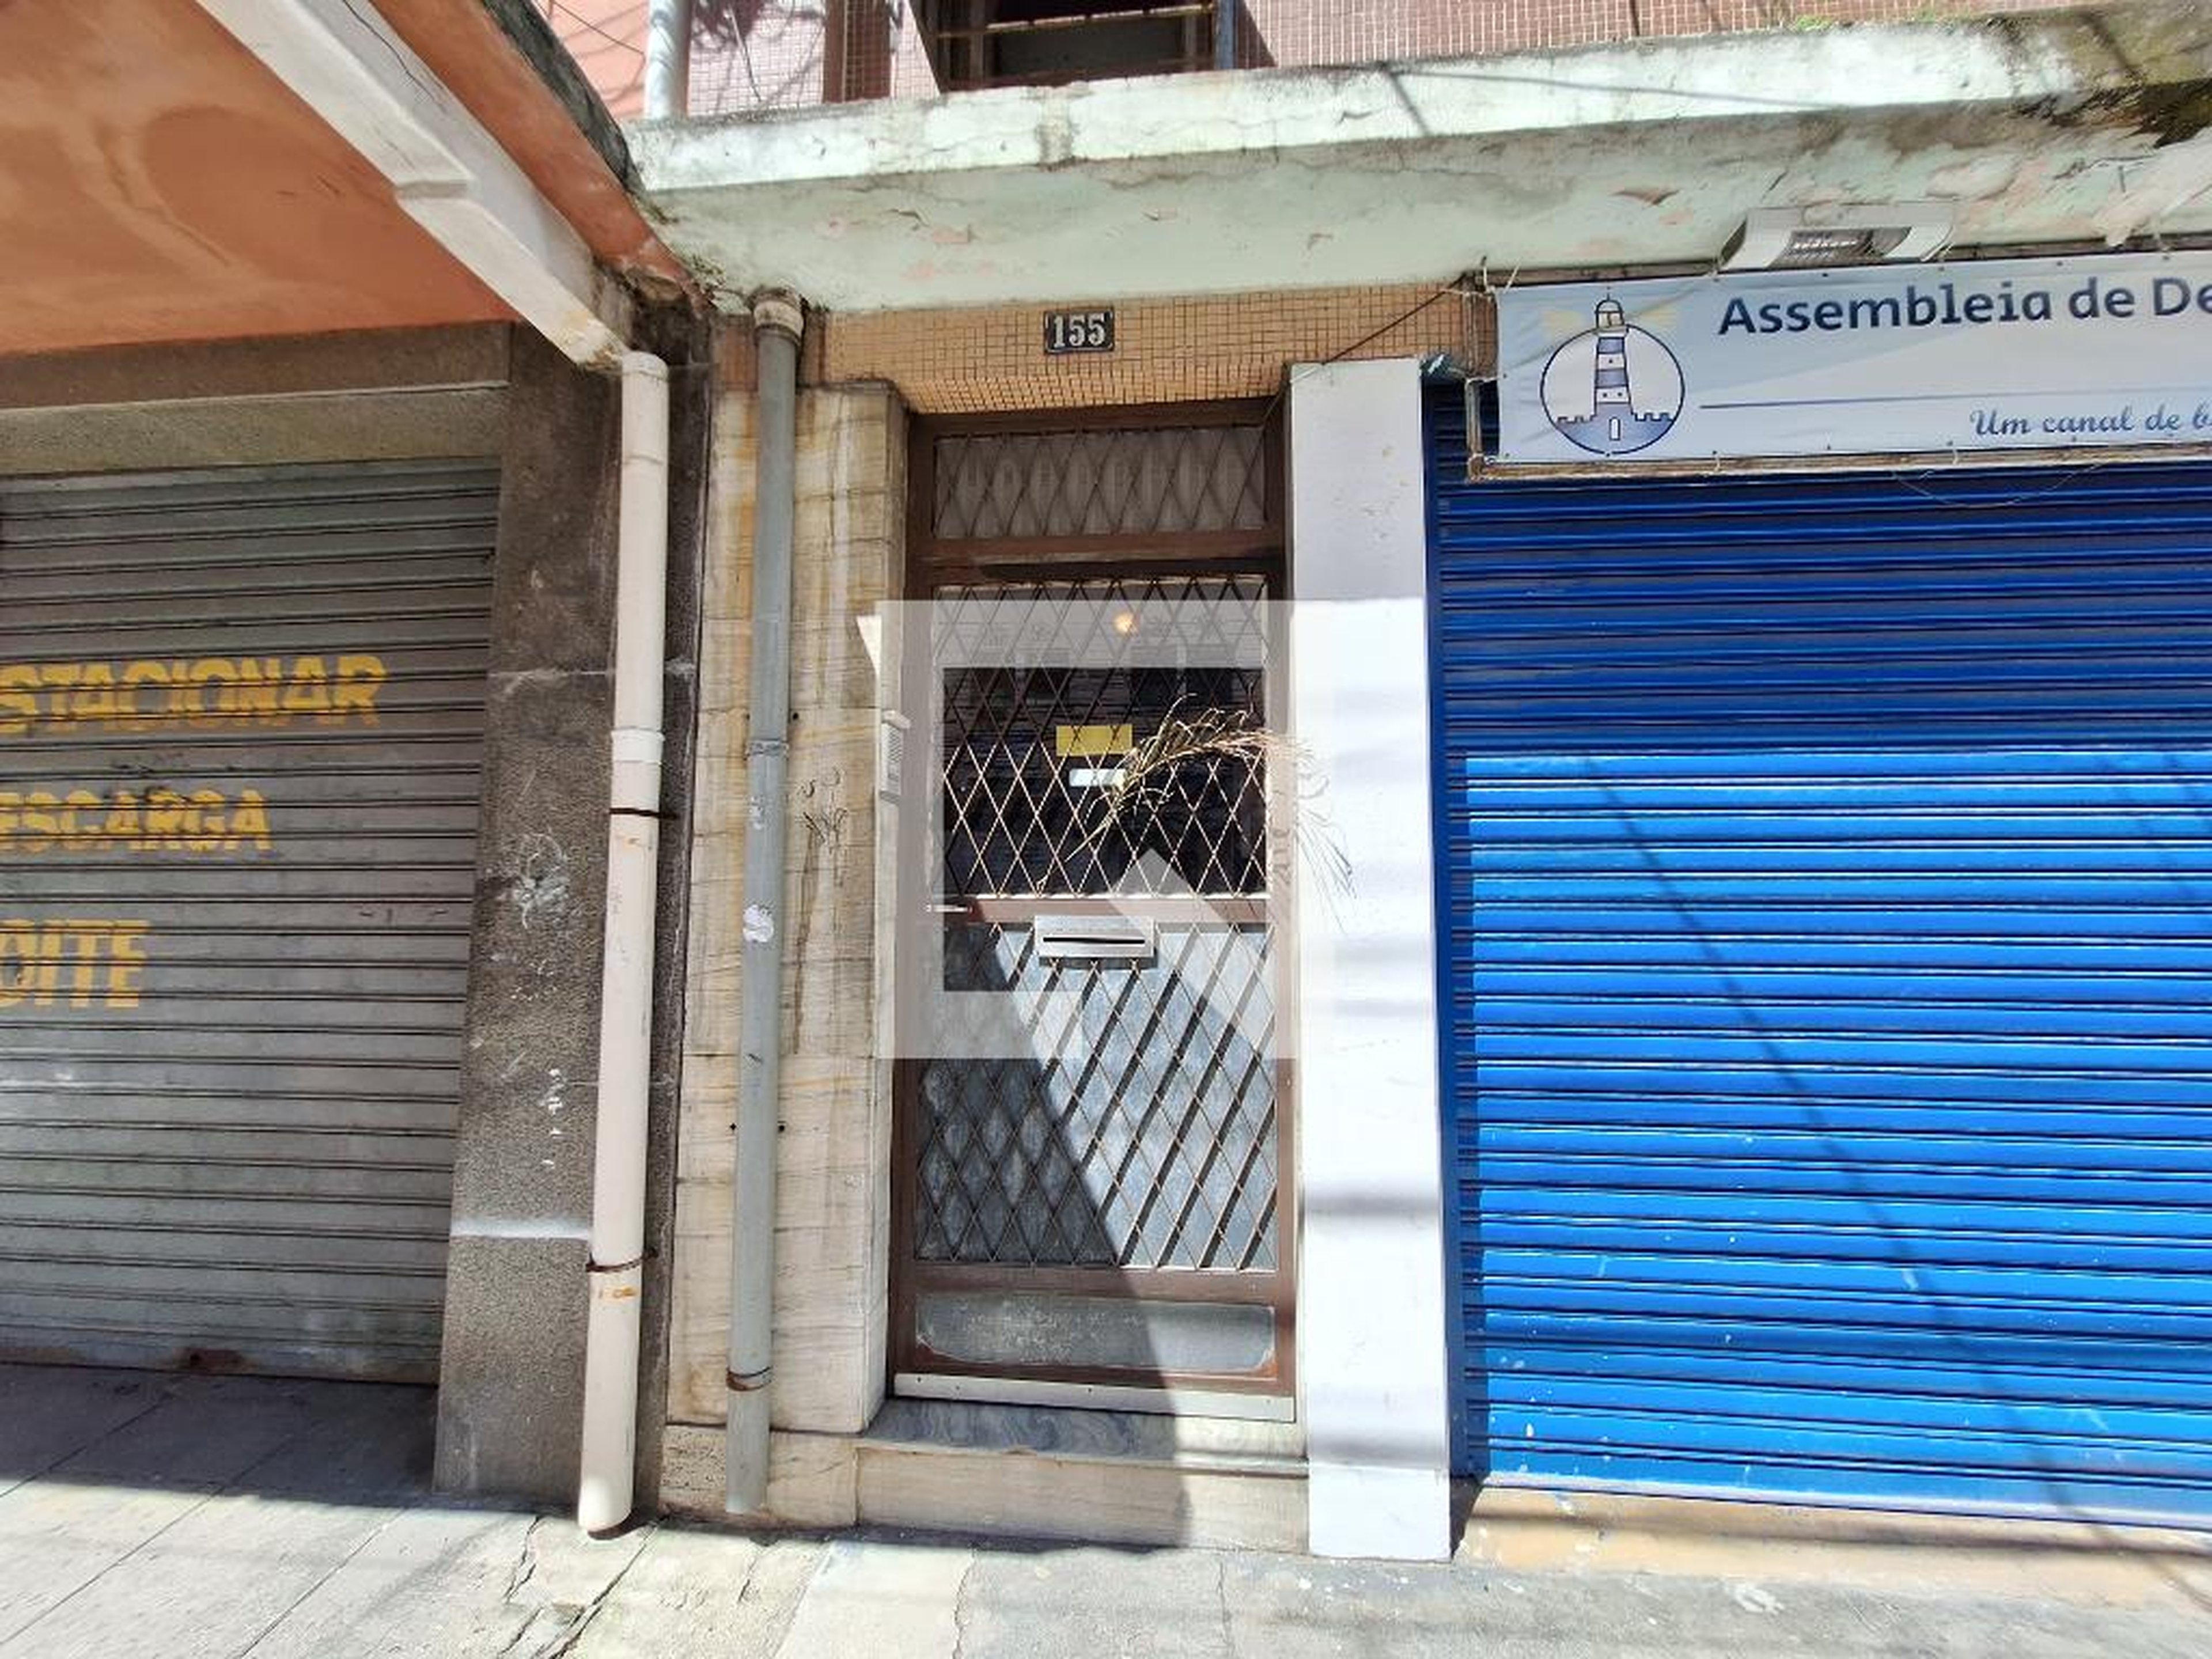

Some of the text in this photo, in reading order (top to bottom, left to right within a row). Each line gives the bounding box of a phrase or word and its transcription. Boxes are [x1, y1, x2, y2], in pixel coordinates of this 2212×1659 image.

[1715, 282, 2052, 335] Assembleia
[2069, 276, 2135, 318] de
[1053, 313, 1105, 349] 155
[1970, 408, 2029, 435] Um
[2042, 406, 2134, 433] canal
[2145, 403, 2180, 431] de
